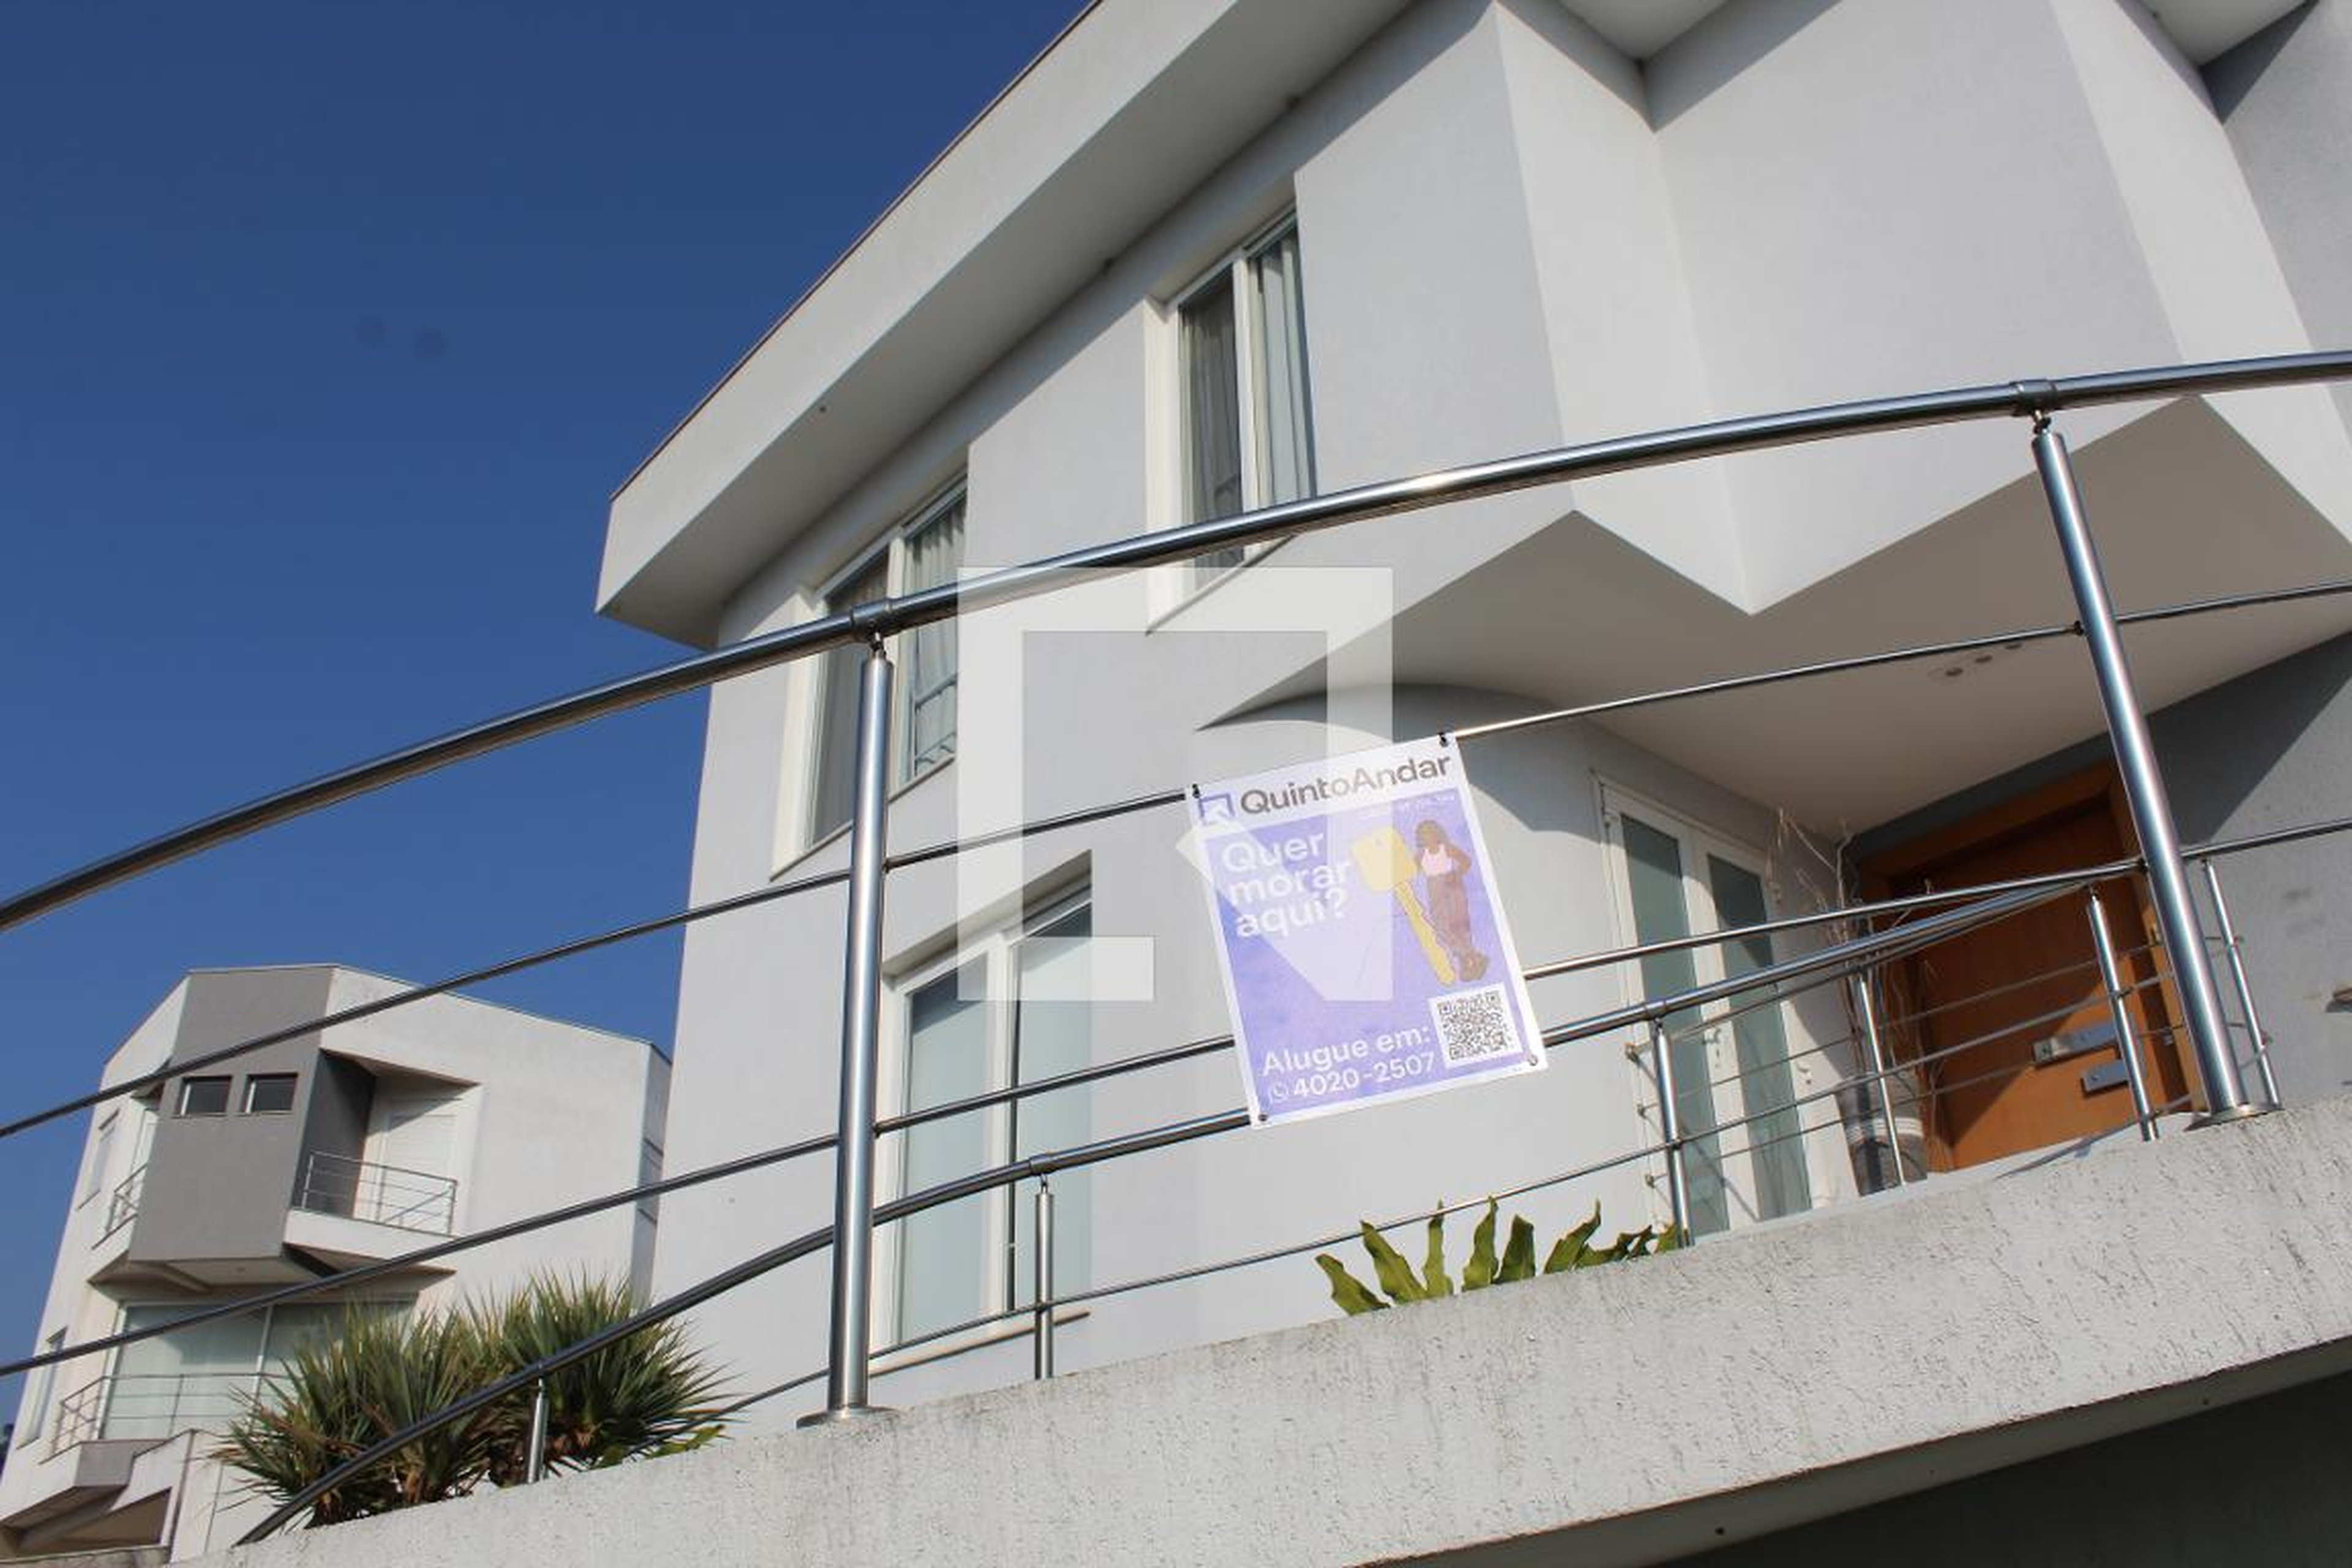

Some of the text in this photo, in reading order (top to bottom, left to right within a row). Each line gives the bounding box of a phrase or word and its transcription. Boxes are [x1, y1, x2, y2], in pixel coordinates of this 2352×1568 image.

[1240, 756, 1451, 815] QuintoAndar
[1224, 832, 1324, 872] Quer
[1229, 861, 1351, 906] morar
[1236, 886, 1348, 937] aqui?
[1262, 1025, 1430, 1076] Alugue em:
[1292, 1052, 1436, 1098] 4020-2507
